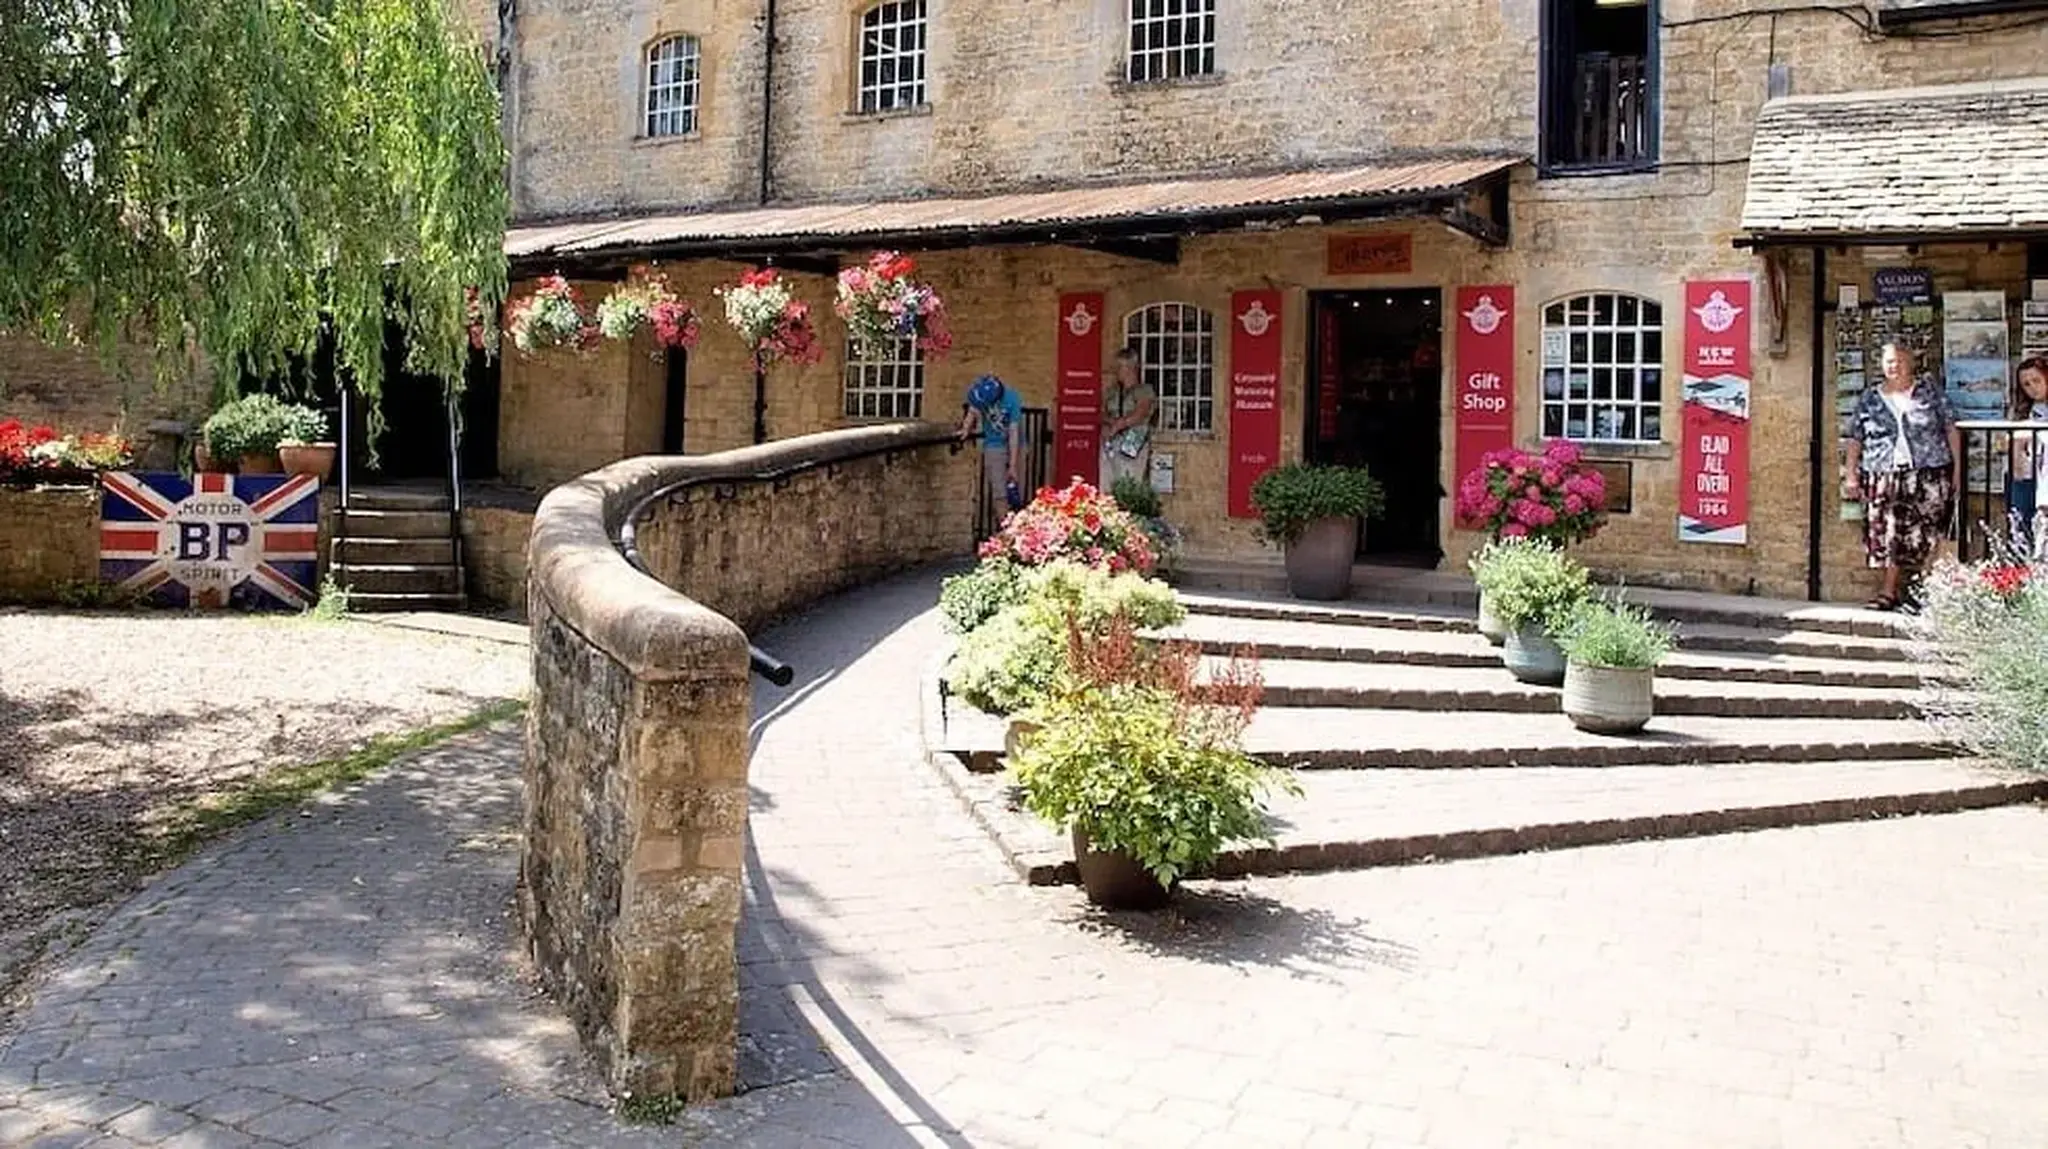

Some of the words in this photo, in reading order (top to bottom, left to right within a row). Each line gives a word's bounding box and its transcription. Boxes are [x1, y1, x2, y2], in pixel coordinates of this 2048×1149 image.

[1468, 372, 1501, 390] Gift
[1463, 393, 1506, 414] Shop
[1701, 435, 1730, 454] GLAD
[1703, 454, 1725, 473] ALL
[182, 502, 243, 515] MOTOR
[178, 521, 250, 562] BP
[180, 566, 240, 581] SPIRIT
